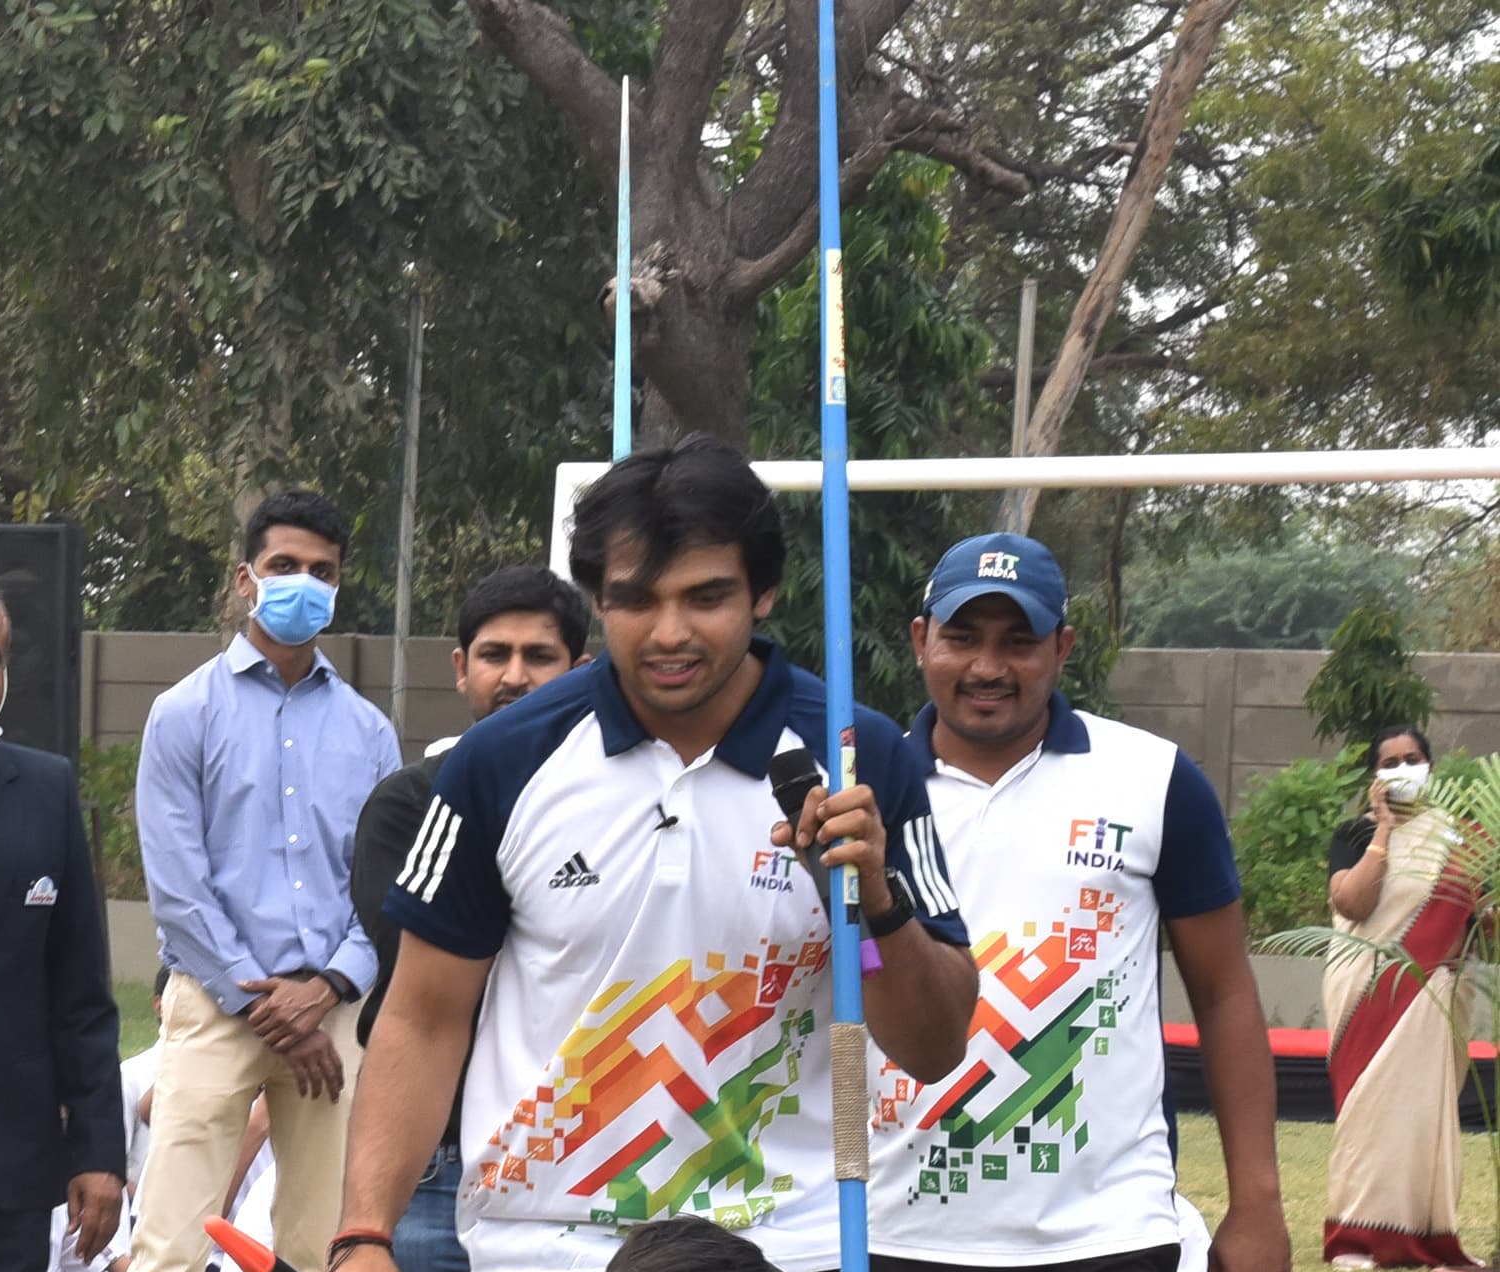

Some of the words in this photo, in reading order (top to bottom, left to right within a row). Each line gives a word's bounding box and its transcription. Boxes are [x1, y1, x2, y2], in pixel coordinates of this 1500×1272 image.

[978, 567, 1018, 580] INDIA
[1066, 850, 1125, 872] INDIA
[548, 871, 600, 889] adidas
[750, 874, 794, 892] INDIA
